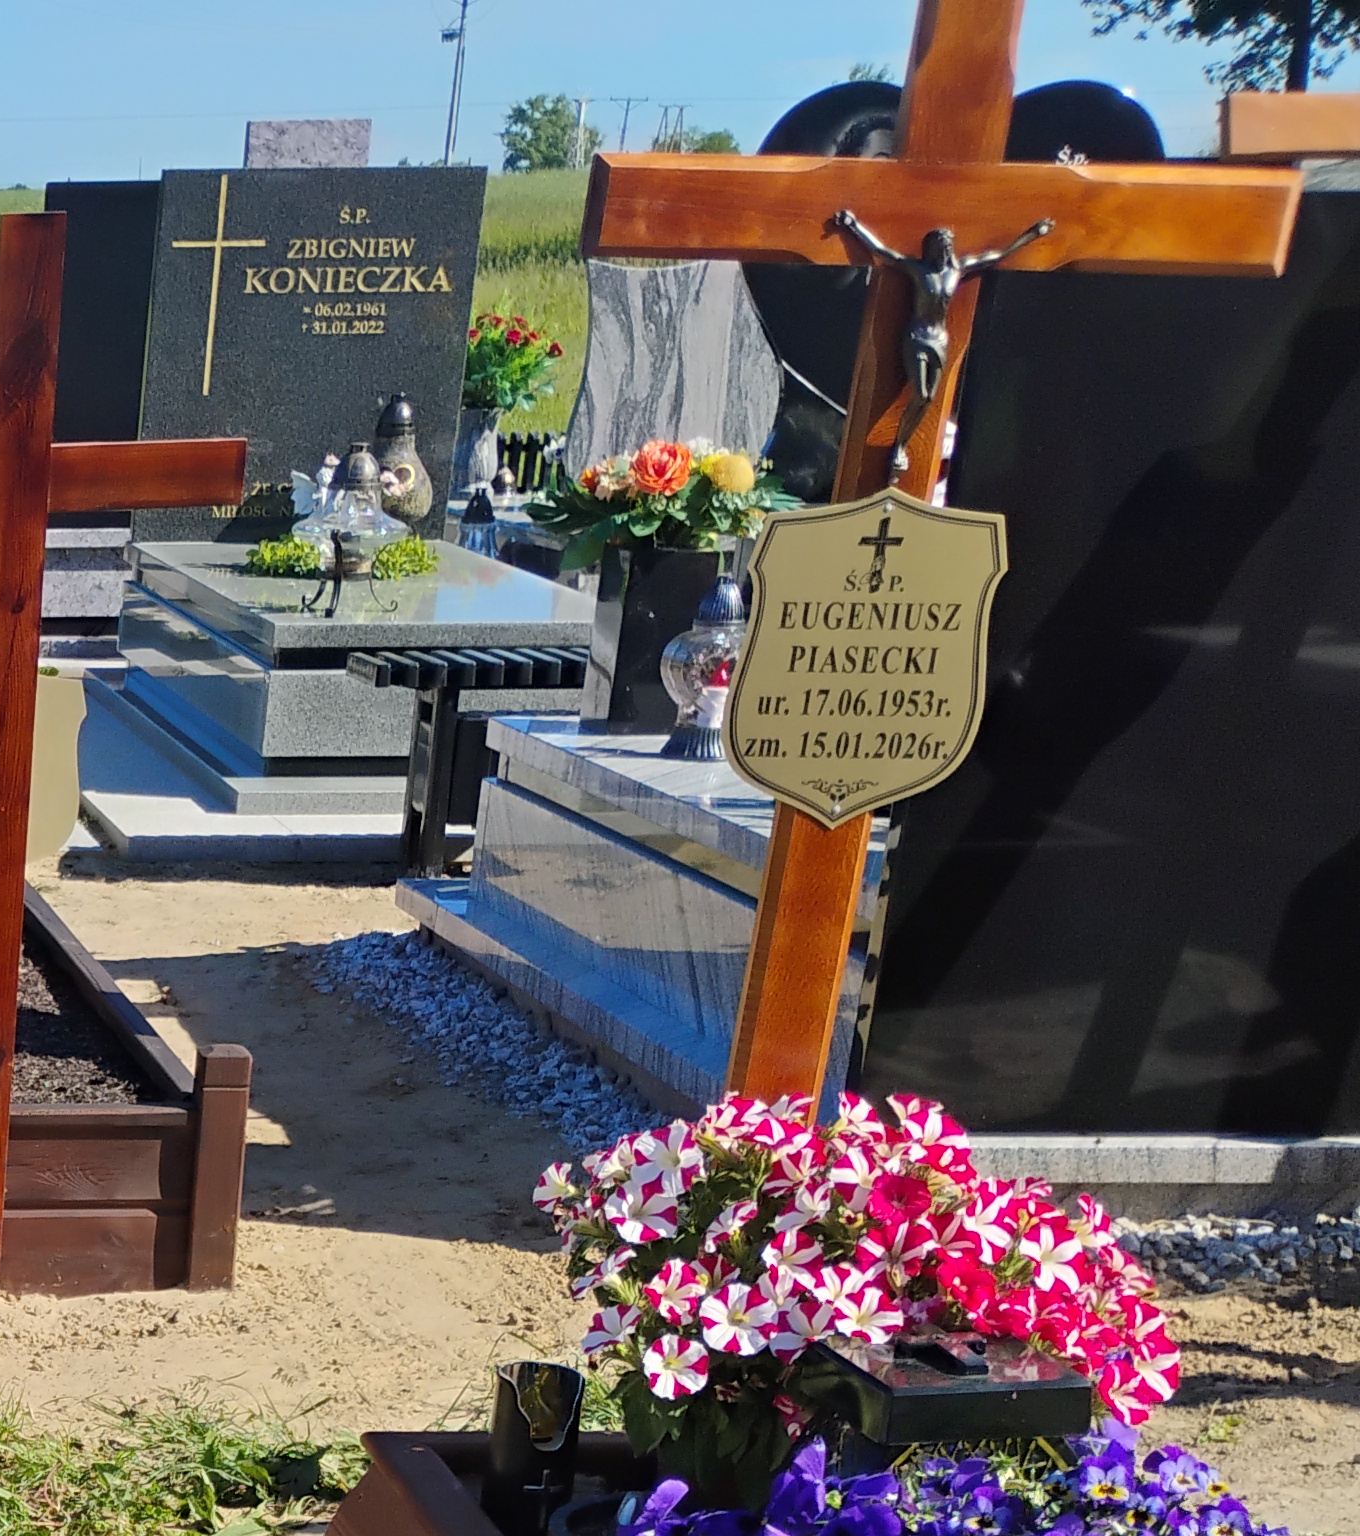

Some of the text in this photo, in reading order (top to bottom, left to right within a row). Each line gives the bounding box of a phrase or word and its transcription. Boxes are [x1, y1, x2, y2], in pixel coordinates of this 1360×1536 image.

[339, 206, 371, 224] Ś.P.
[287, 238, 416, 259] ZBIGNIEW
[243, 265, 452, 294] KONIECZKA
[314, 303, 387, 316] 06.02.1961
[311, 321, 385, 335] 31.01.2022
[888, 574, 904, 592] P.
[779, 601, 964, 632] EUGENIUSZ
[787, 645, 940, 675] PIASECKI
[757, 688, 952, 718] ur. 17.06.1953r.
[744, 731, 950, 760] zm. 15.01.2026r.
